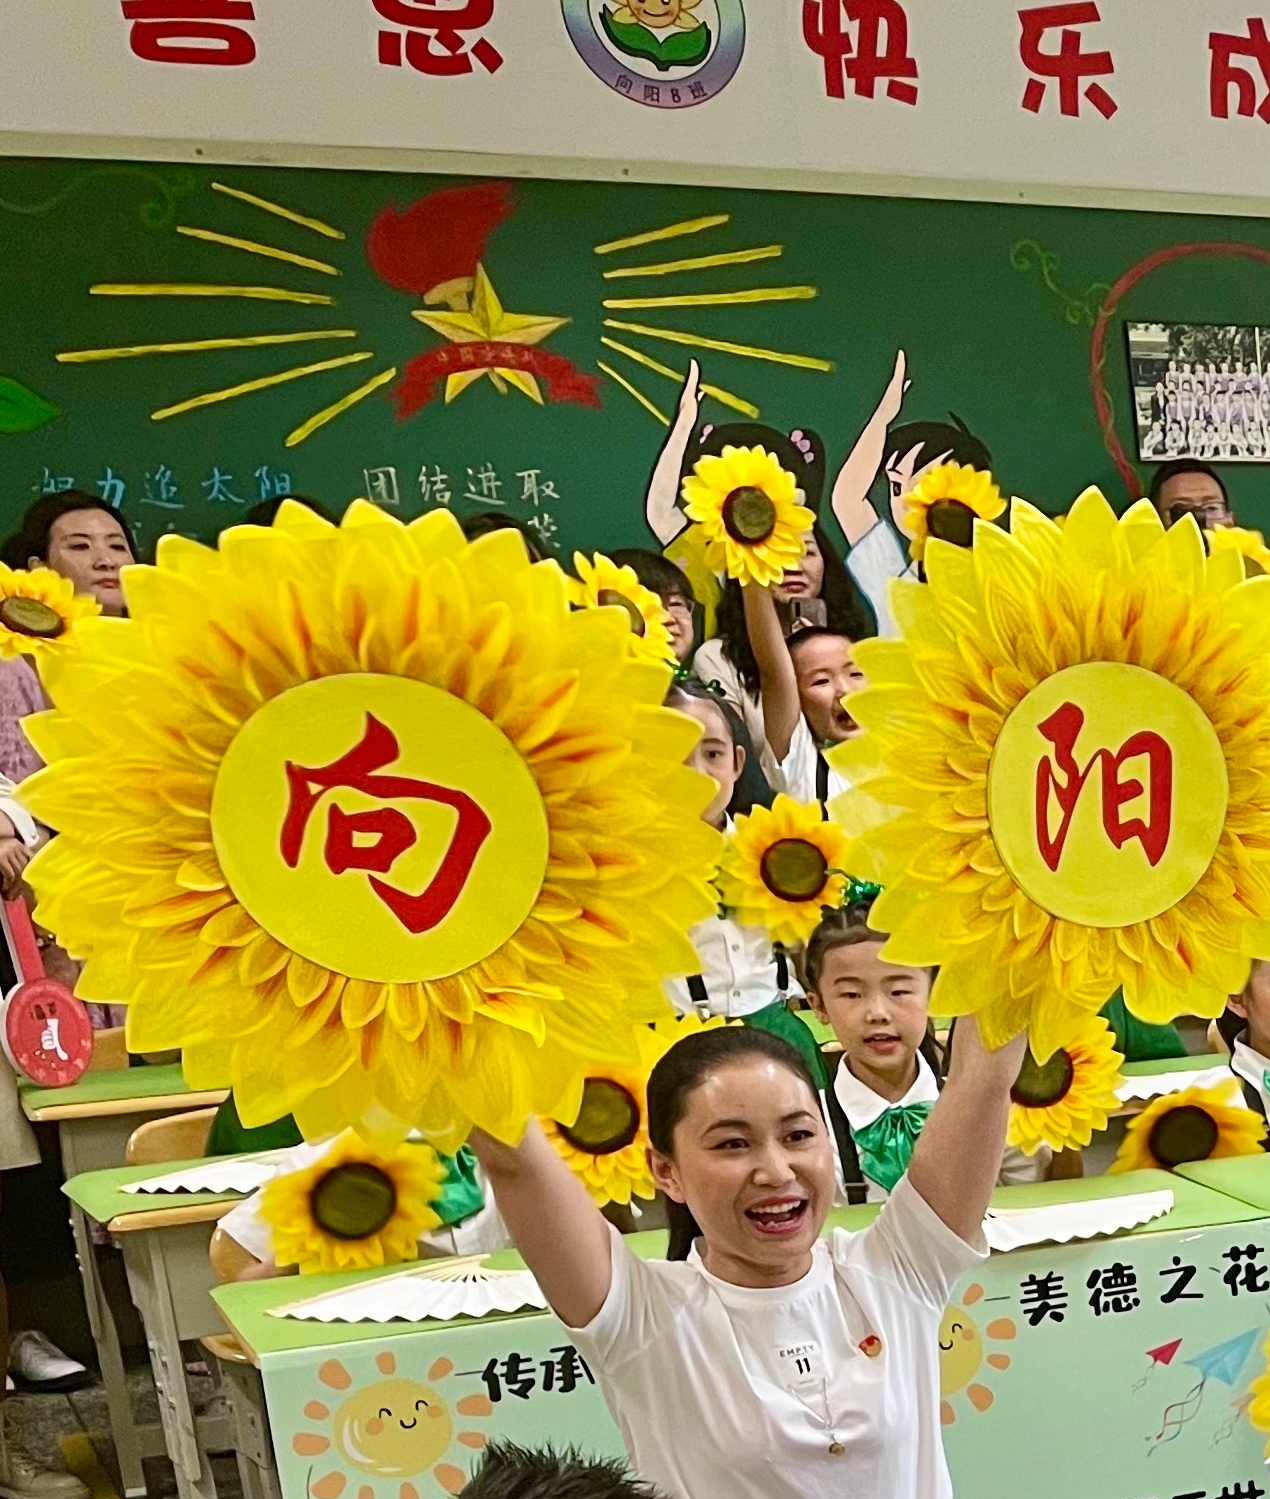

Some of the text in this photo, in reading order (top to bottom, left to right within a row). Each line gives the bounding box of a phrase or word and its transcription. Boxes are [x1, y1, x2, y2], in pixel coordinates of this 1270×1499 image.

[614, 74, 709, 103] 向阳8班
[362, 464, 562, 507] 团结进取
[1034, 700, 1175, 874] 阳
[279, 710, 493, 935] 向
[1019, 1243, 1270, 1326] 美德之花
[481, 1344, 596, 1403] 传承
[779, 1344, 815, 1358] EMPTY
[795, 1357, 811, 1375] 11
